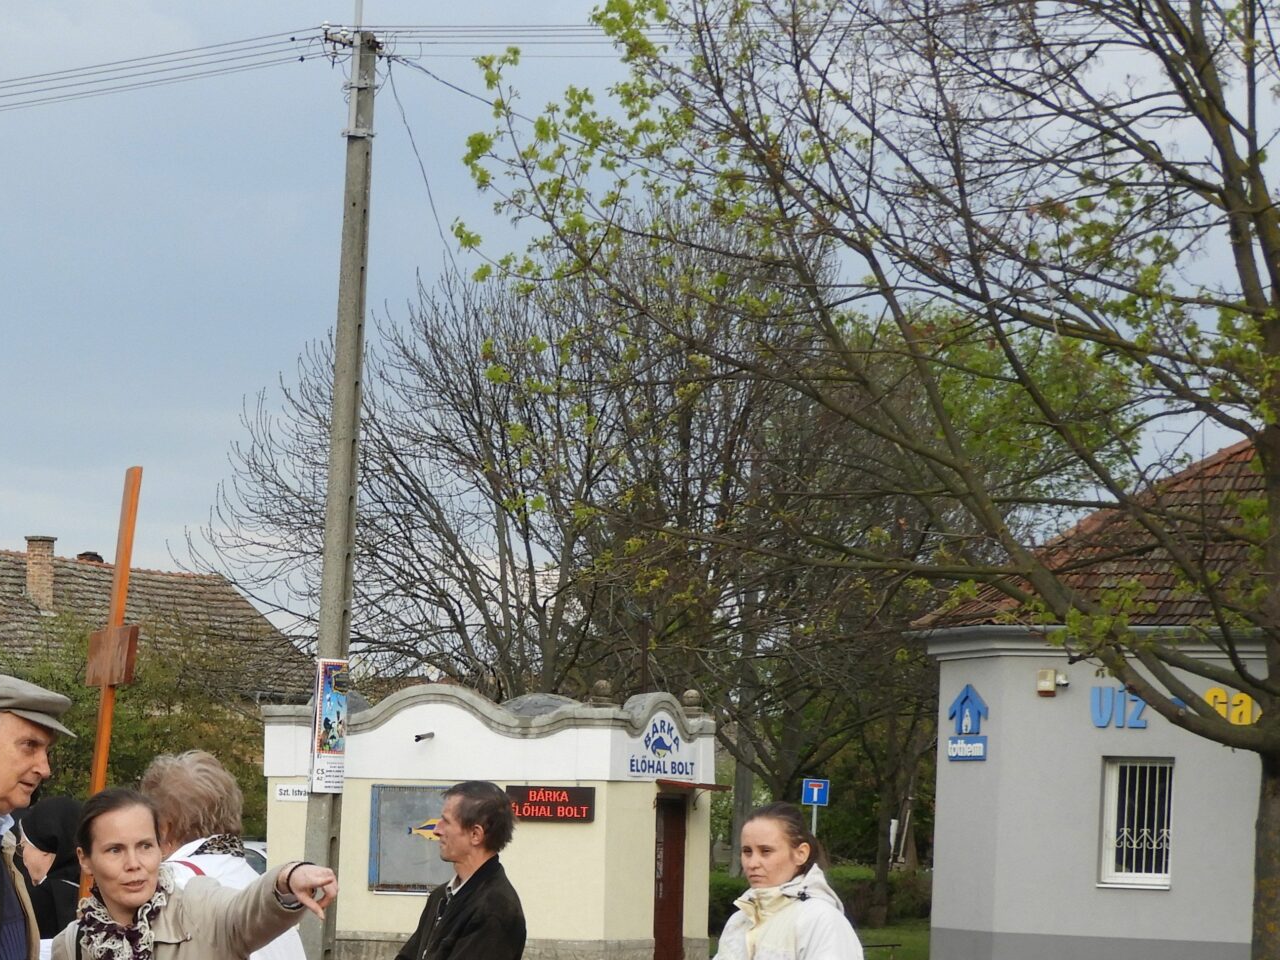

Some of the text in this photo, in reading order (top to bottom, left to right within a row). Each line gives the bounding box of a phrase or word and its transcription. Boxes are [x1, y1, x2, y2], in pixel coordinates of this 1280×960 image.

[644, 718, 679, 752] BÁRKA
[630, 754, 695, 775] ÉLŐHAL BOLT
[528, 788, 569, 802] BÁRKA
[557, 806, 589, 818] BOLT
